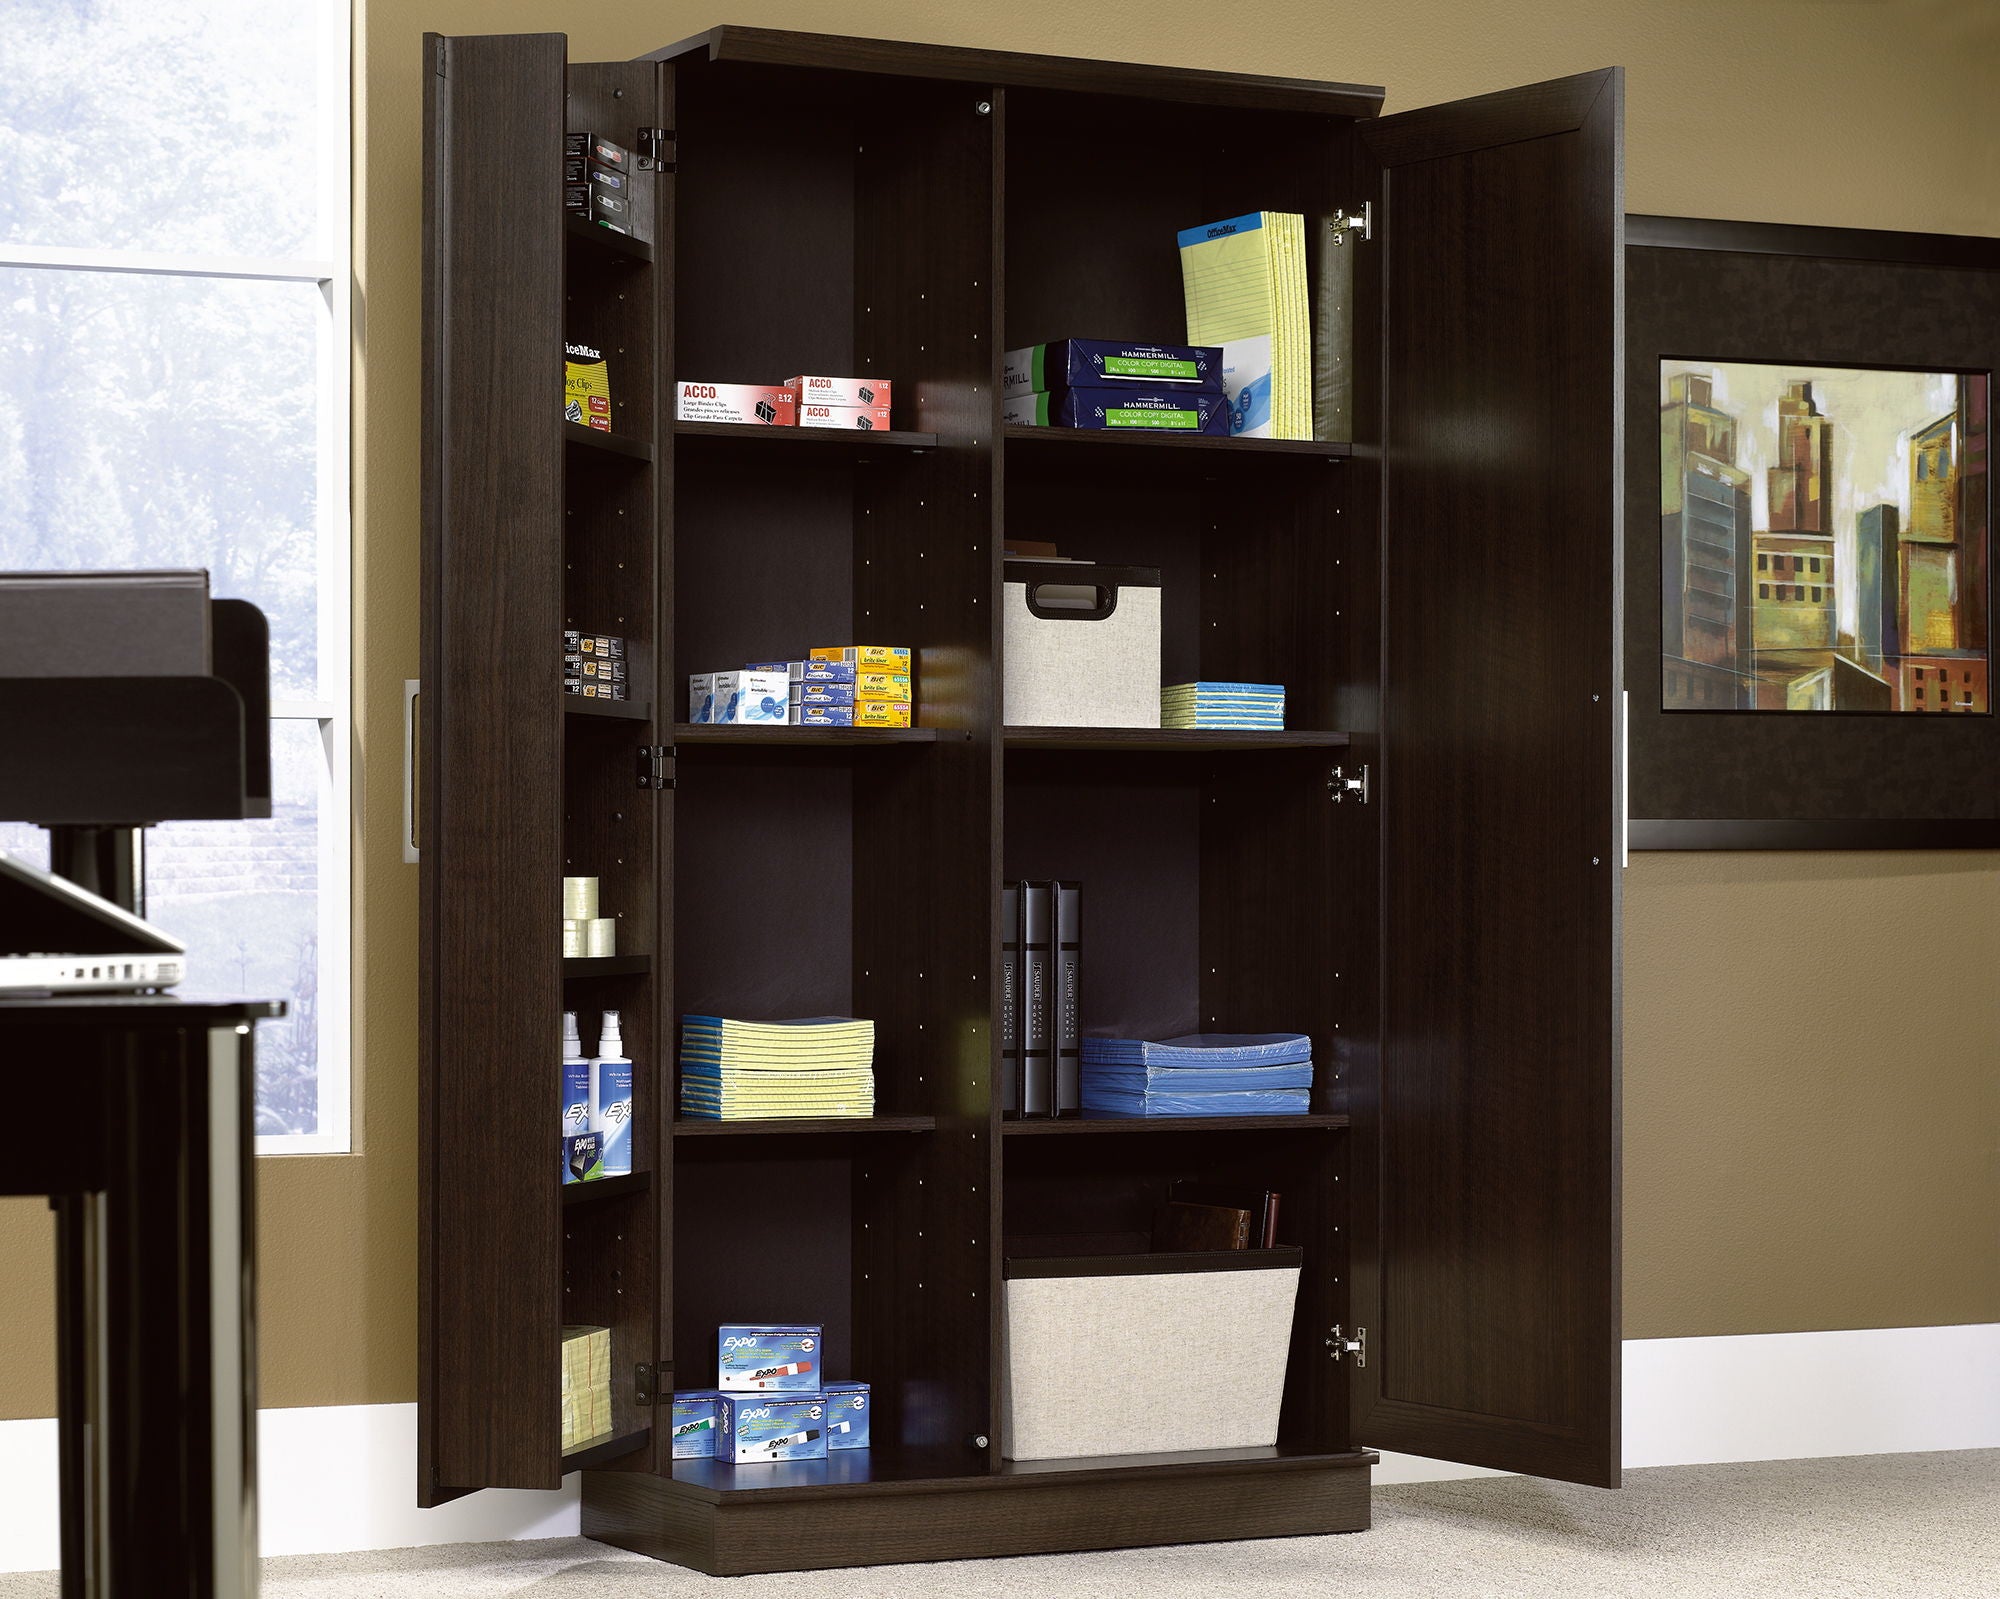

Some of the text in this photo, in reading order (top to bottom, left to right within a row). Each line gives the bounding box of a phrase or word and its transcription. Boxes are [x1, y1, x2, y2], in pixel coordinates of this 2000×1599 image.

[1207, 225, 1237, 238] OfficeMax
[565, 342, 601, 359] iceMax
[1121, 351, 1179, 360] HAMMERMILL
[808, 378, 832, 389] ACCO
[1004, 373, 1030, 386] RMILL
[683, 385, 717, 399] ACCO
[783, 394, 793, 403] 12
[1123, 402, 1181, 410] HAMMERMILL
[806, 407, 830, 418] ACCO
[1143, 411, 1160, 419] COPY
[870, 648, 885, 656] BIC
[564, 1103, 589, 1125] EX
[575, 1137, 587, 1155] EXPO
[723, 1336, 757, 1351] EXPO
[755, 1368, 777, 1378] EXPO
[740, 1408, 770, 1423] EXPO
[680, 1422, 700, 1434] EXPO
[768, 1438, 788, 1448] EXPO
